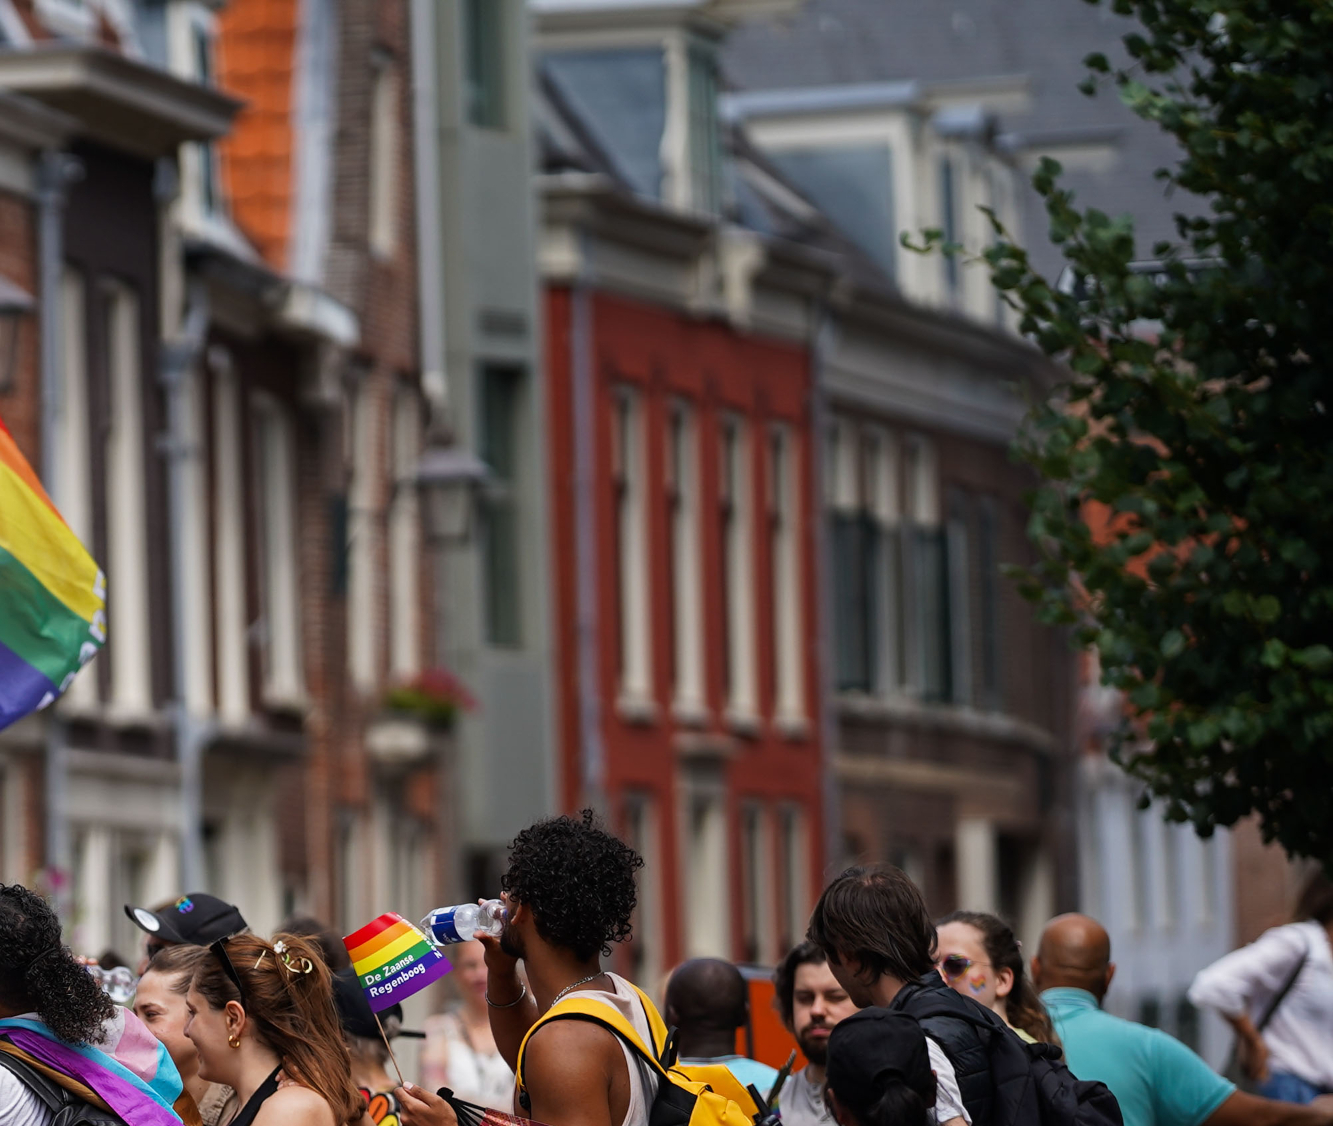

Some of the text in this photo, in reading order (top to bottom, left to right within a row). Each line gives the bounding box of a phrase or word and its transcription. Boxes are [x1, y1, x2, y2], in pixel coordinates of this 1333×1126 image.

[365, 952, 415, 986] De Zaanse
[369, 962, 426, 998] Regenboog
